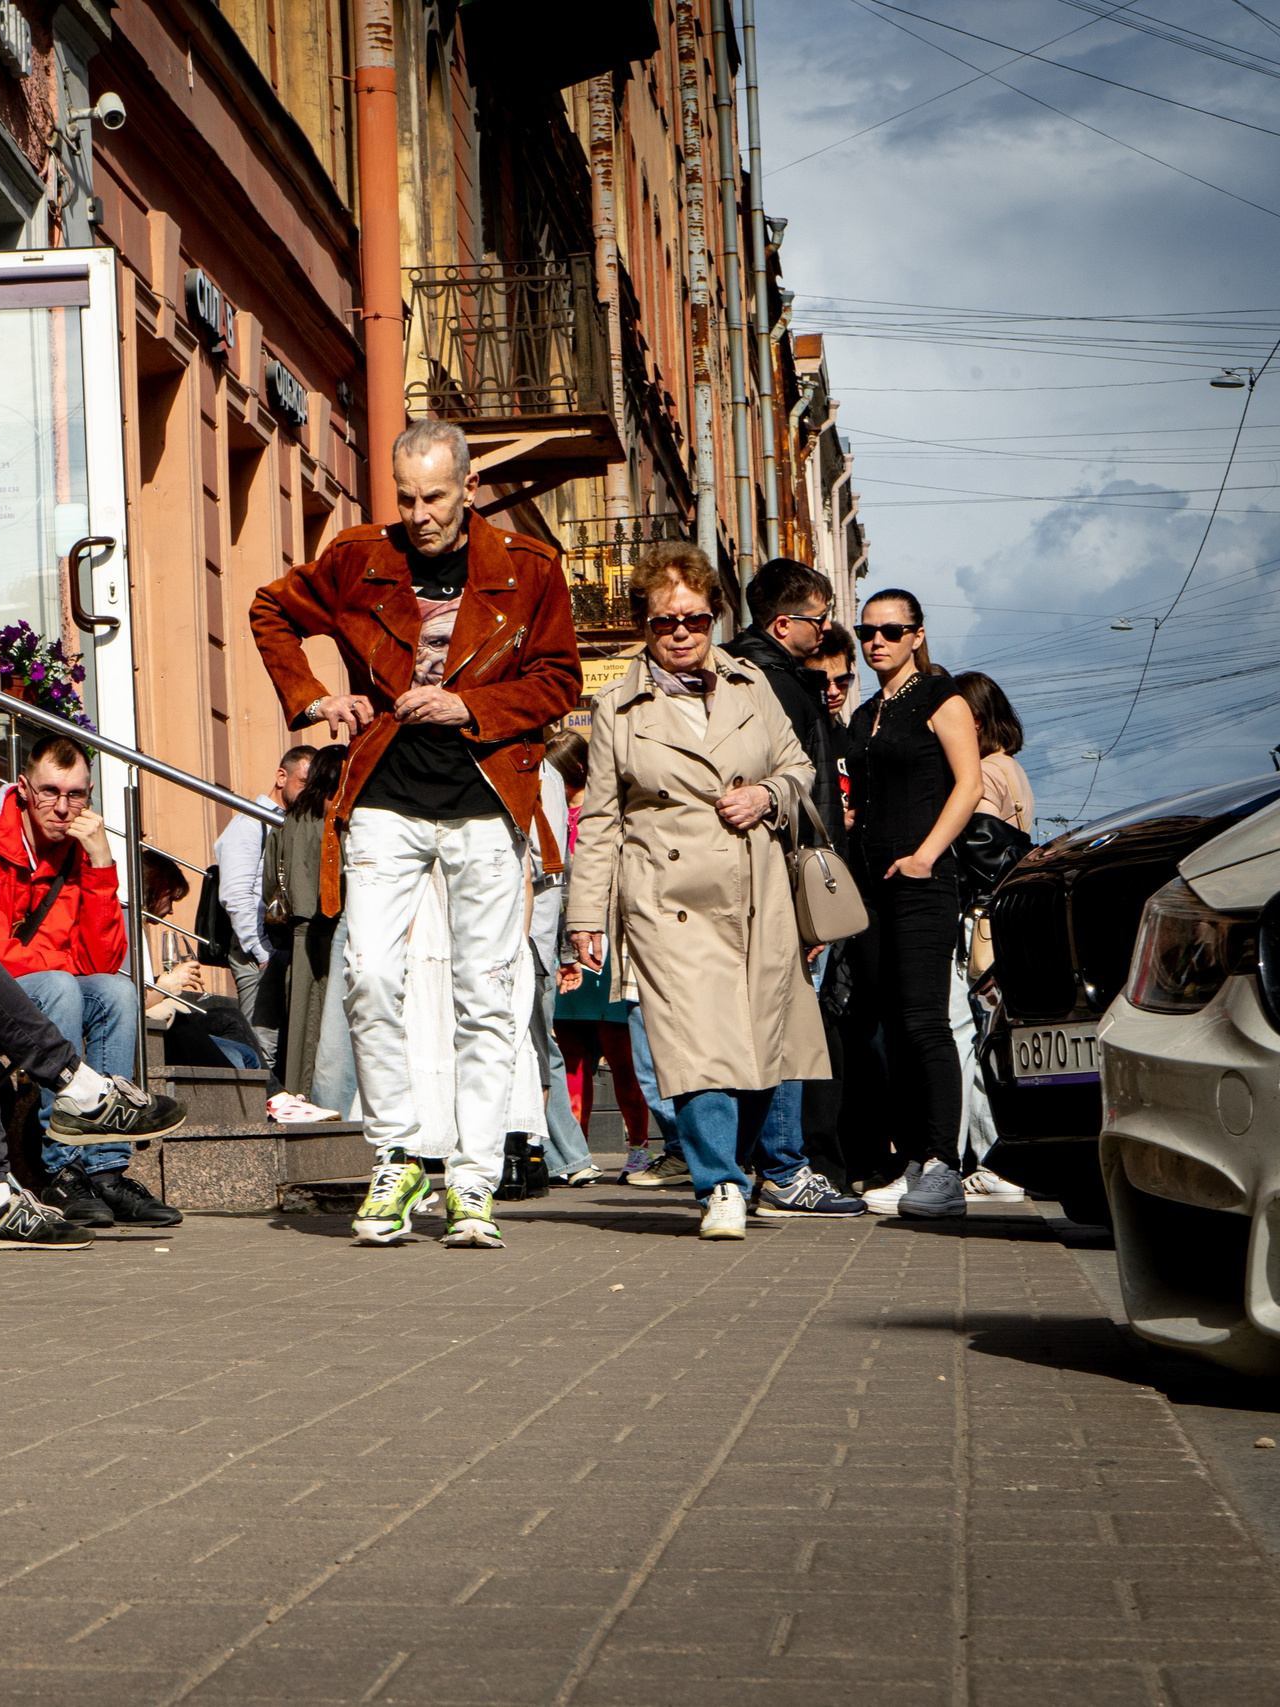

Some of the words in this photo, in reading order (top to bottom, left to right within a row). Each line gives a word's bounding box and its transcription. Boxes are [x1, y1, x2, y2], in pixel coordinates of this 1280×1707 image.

[584, 673, 609, 682] ТАТУ
[103, 1104, 138, 1132] N
[795, 1188, 824, 1209] N
[6, 1207, 43, 1237] N
